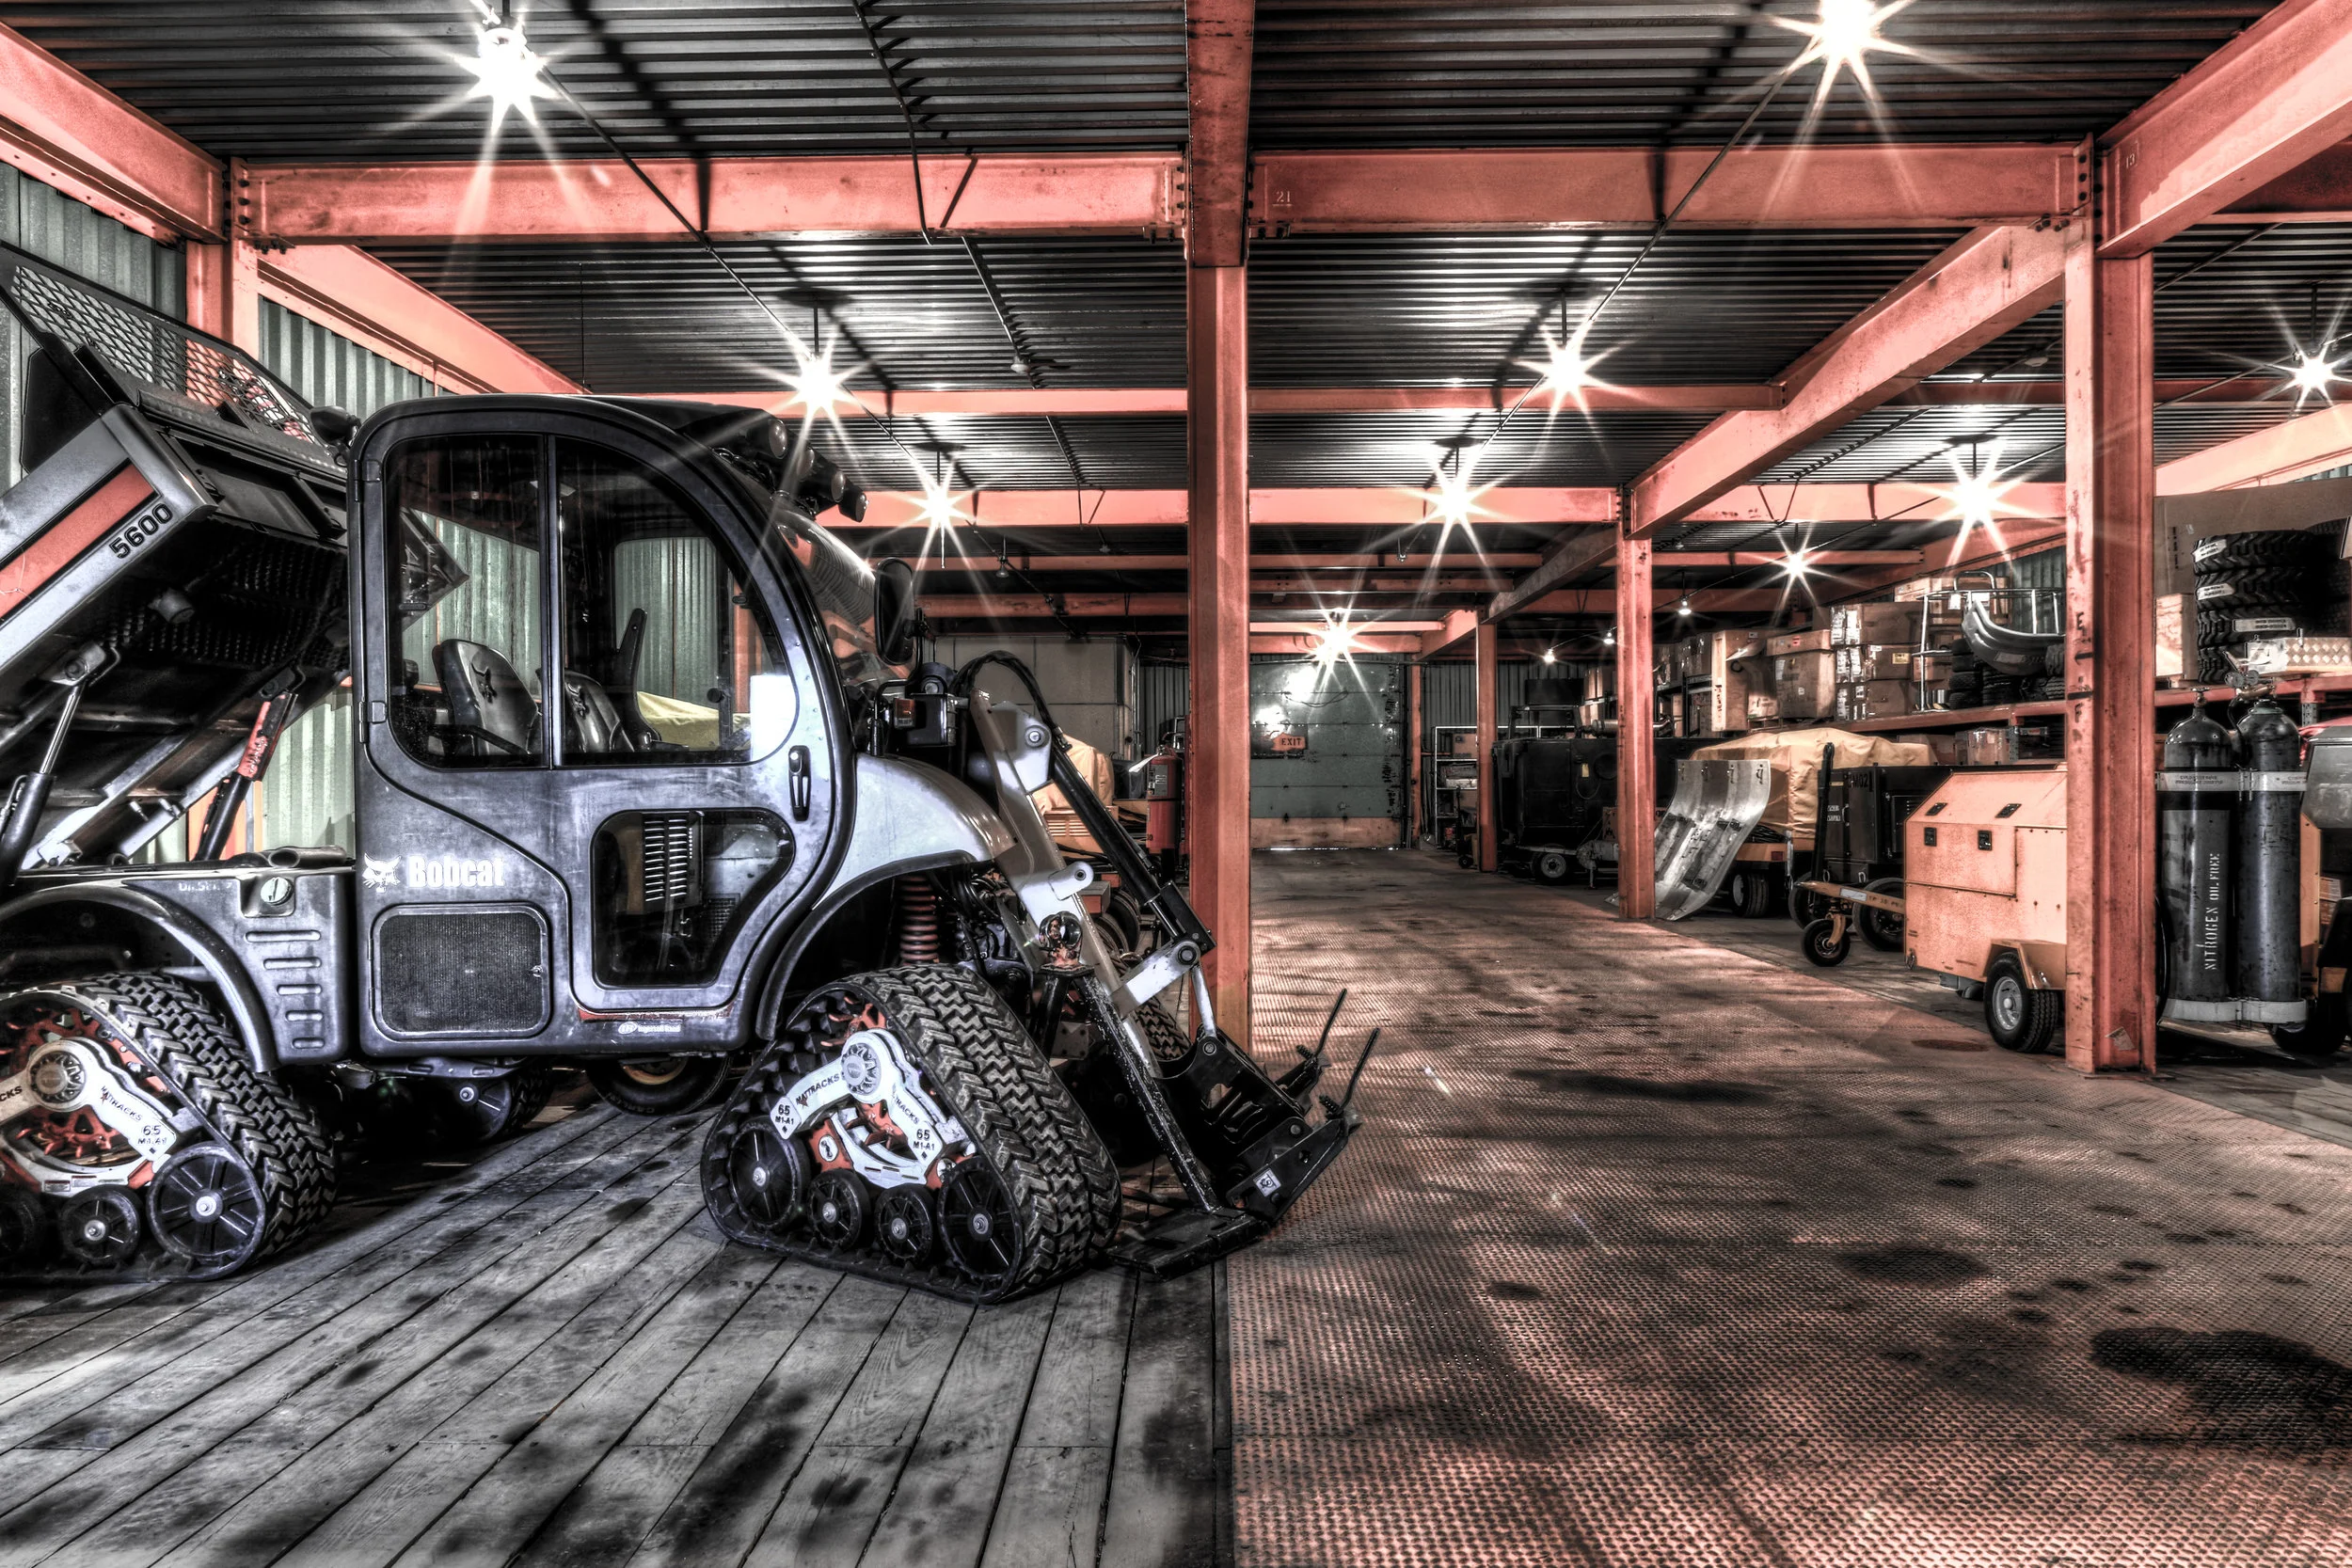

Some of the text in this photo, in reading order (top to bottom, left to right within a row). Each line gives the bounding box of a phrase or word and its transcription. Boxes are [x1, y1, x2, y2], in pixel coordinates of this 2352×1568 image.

[108, 502, 173, 559] 5600
[1281, 737, 1301, 746] EXIT
[407, 854, 505, 888] Bobcat
[2204, 907, 2218, 970] NITROGEN
[0, 1085, 23, 1101] CKS
[796, 1073, 840, 1104] MATTRACKS
[101, 1085, 142, 1121] MATTRACKS
[778, 1104, 790, 1116] 65
[775, 1116, 794, 1125] M1-A1
[143, 1125, 161, 1136] 65
[916, 1129, 930, 1140] 65
[913, 1141, 935, 1150] M1-A1
